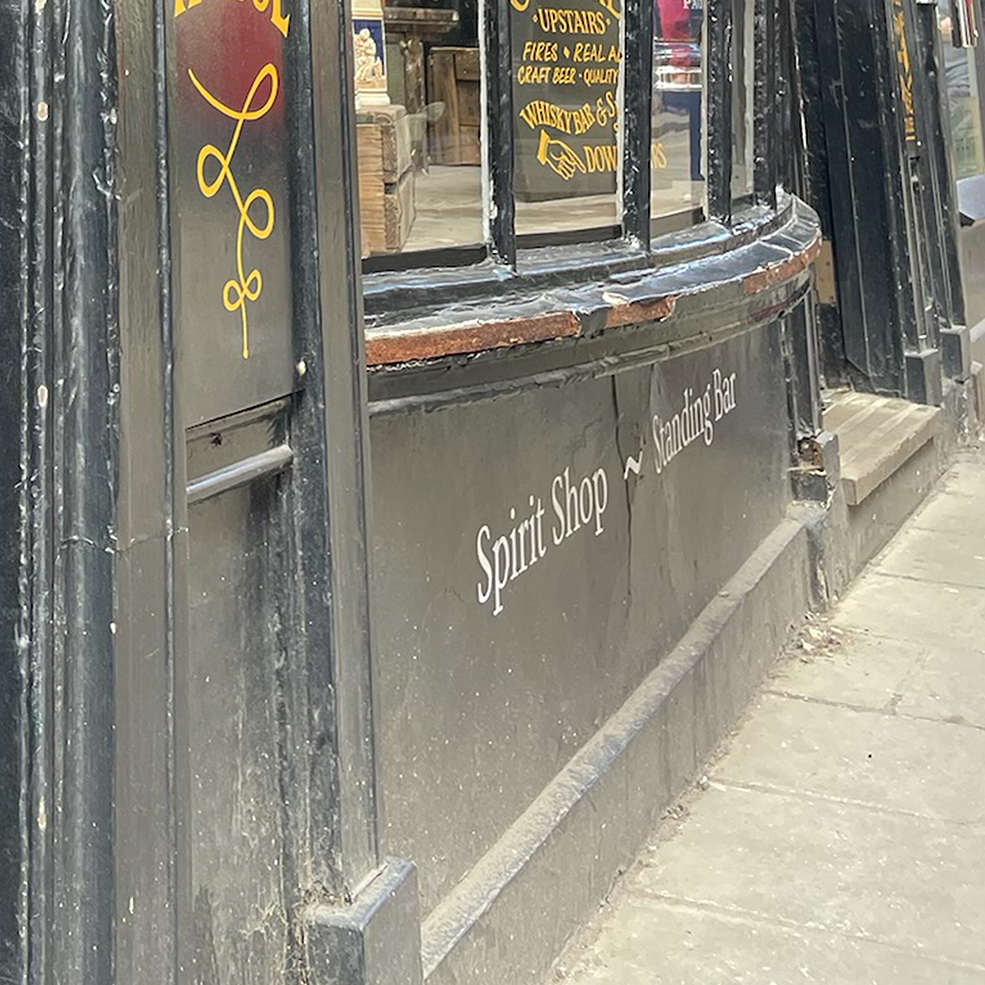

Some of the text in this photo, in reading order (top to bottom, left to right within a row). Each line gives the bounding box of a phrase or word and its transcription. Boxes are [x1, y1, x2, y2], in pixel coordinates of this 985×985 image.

[537, 8, 606, 34] UPSTAIRS
[522, 42, 623, 62] FIRES REAL AL
[517, 66, 618, 85] CRAFT BEER QUALITY
[520, 99, 573, 135] WHISKY
[572, 102, 596, 135] BAR
[596, 97, 608, 127] &
[476, 495, 547, 616] Spirit
[551, 466, 608, 546] Shop
[652, 384, 714, 475] Standing
[712, 368, 737, 422] Bar
